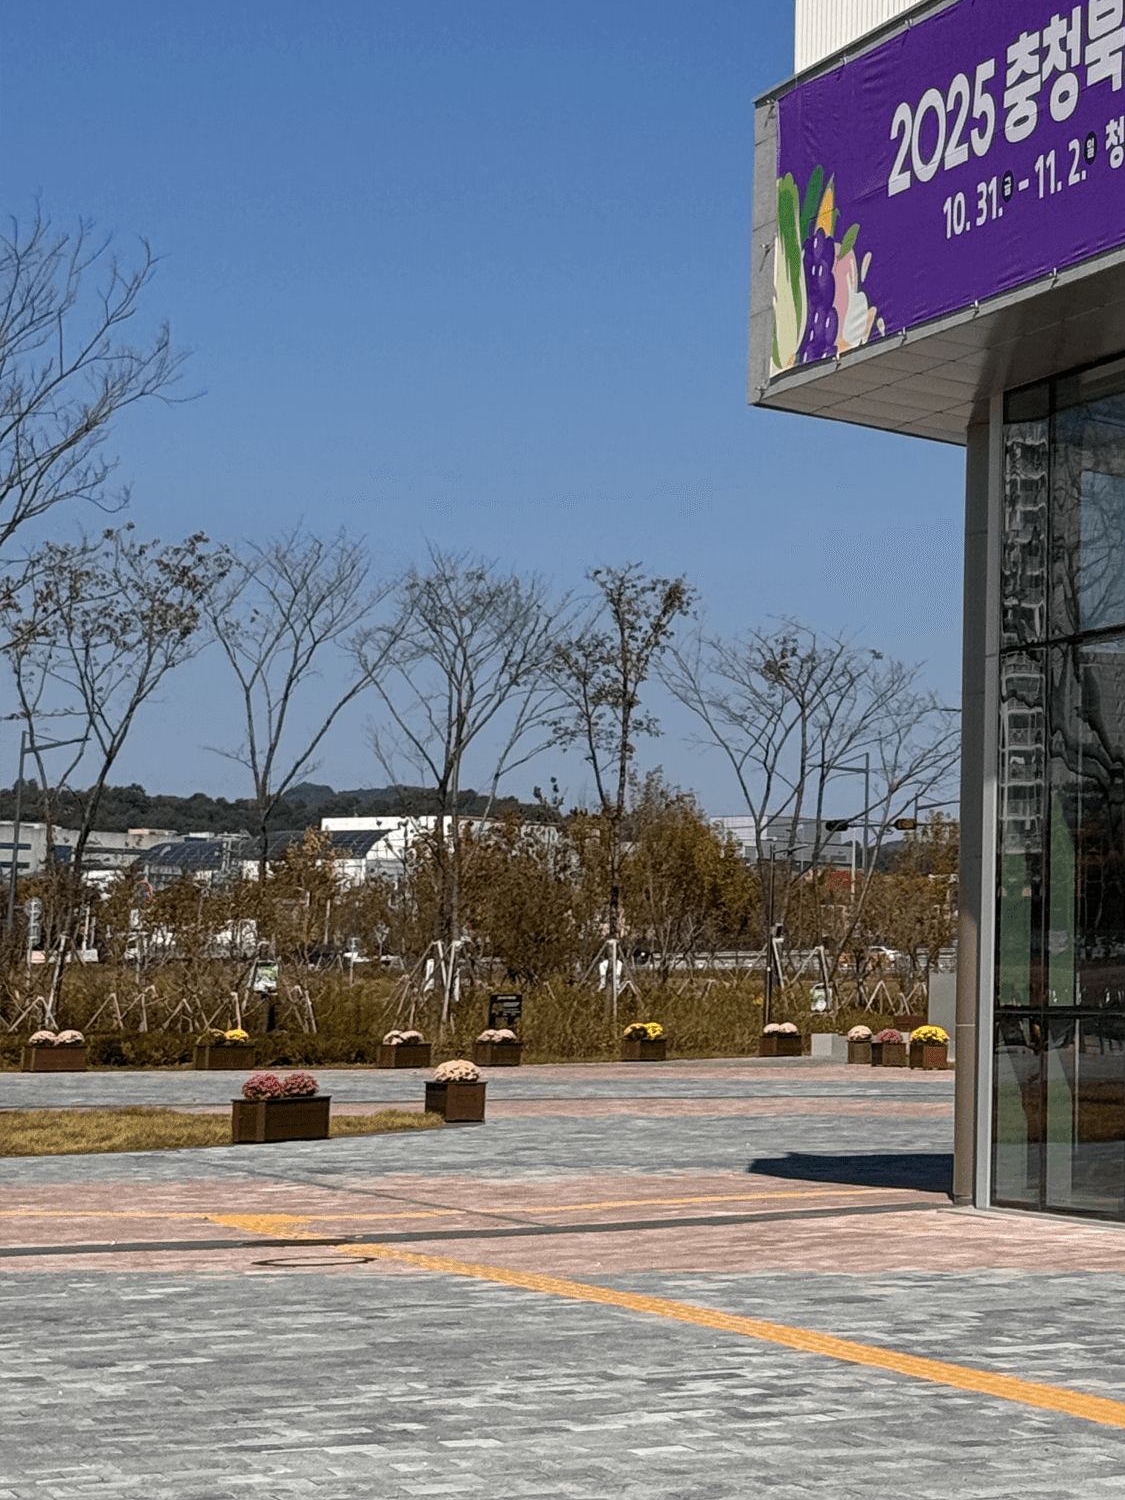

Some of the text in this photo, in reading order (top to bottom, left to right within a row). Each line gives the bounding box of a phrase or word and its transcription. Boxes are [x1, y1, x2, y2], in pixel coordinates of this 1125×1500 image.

[888, 58, 995, 197] 2025
[943, 192, 971, 239] 10.
[1034, 149, 1062, 199] 11.
